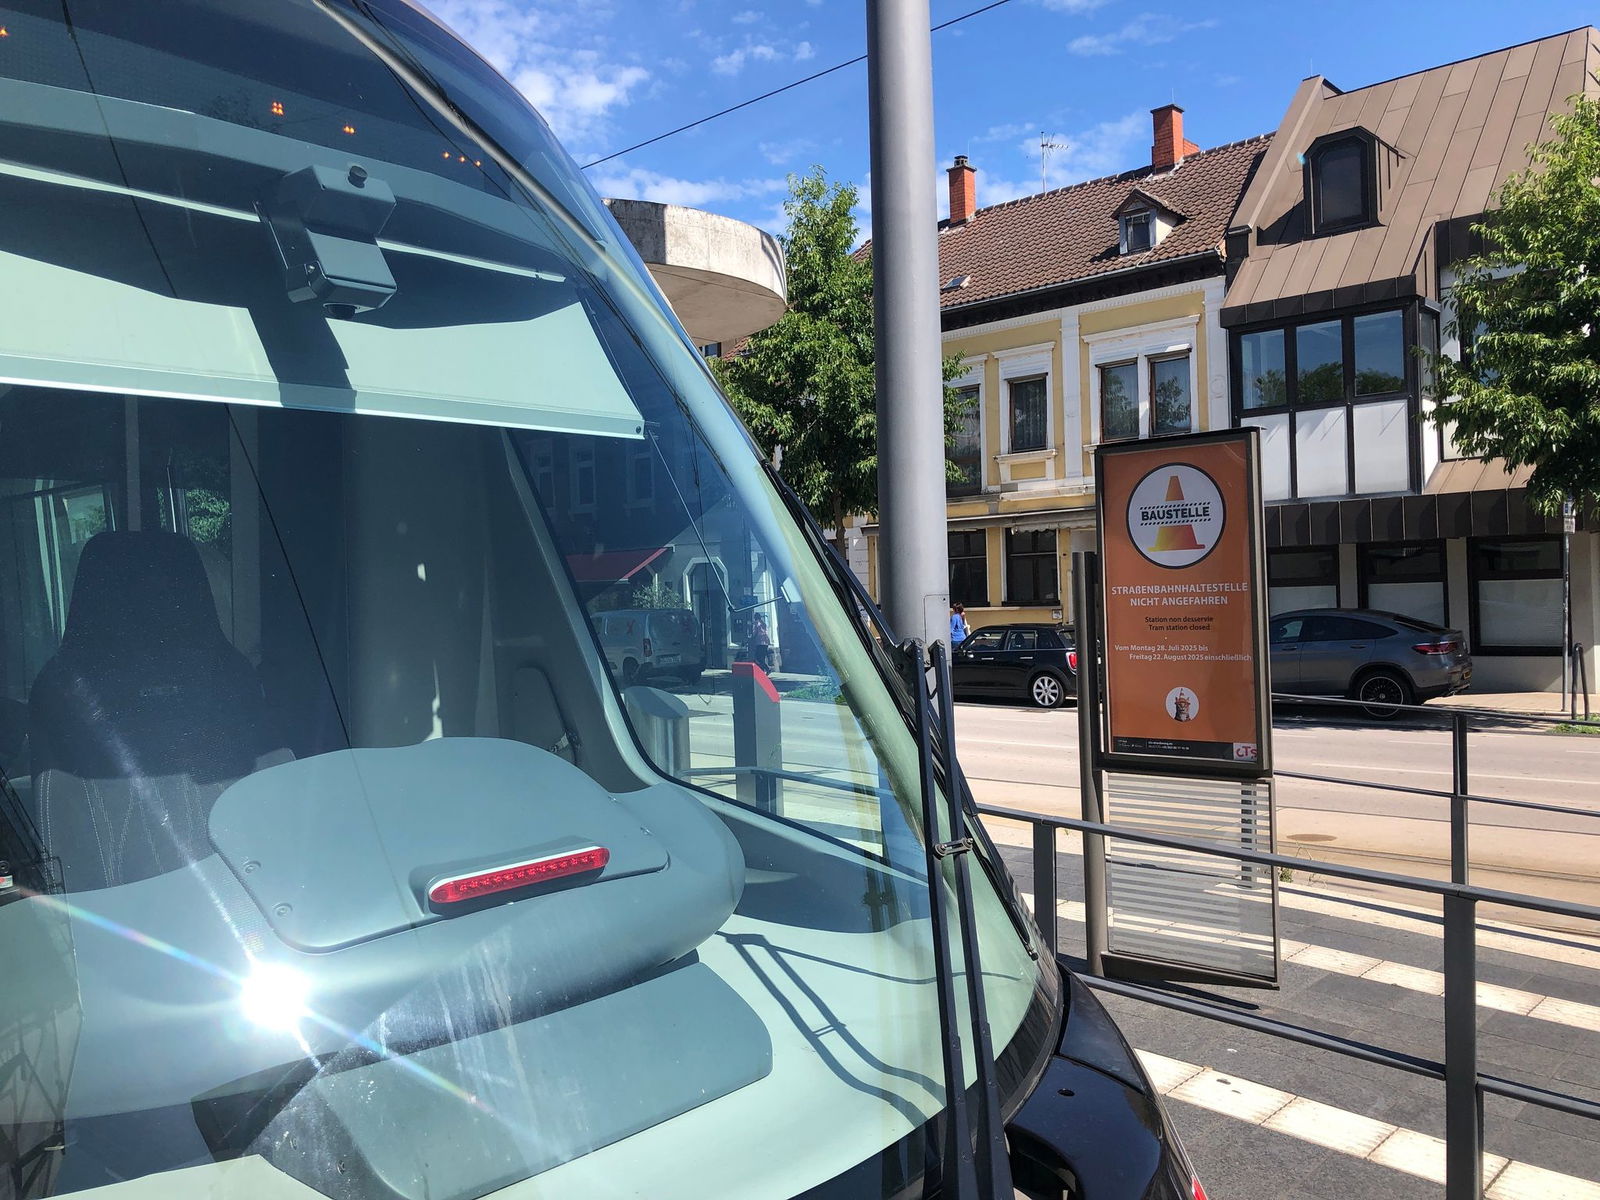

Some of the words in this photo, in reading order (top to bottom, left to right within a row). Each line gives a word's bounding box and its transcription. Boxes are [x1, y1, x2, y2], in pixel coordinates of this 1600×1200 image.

[1141, 506, 1210, 521] BAUSTELLE
[1111, 582, 1249, 595] STRAßENBAHNHALTESTELLE
[1130, 597, 1160, 606] NICHT
[1162, 596, 1228, 606] ANGEFAHREN
[1129, 653, 1152, 661] Freitag
